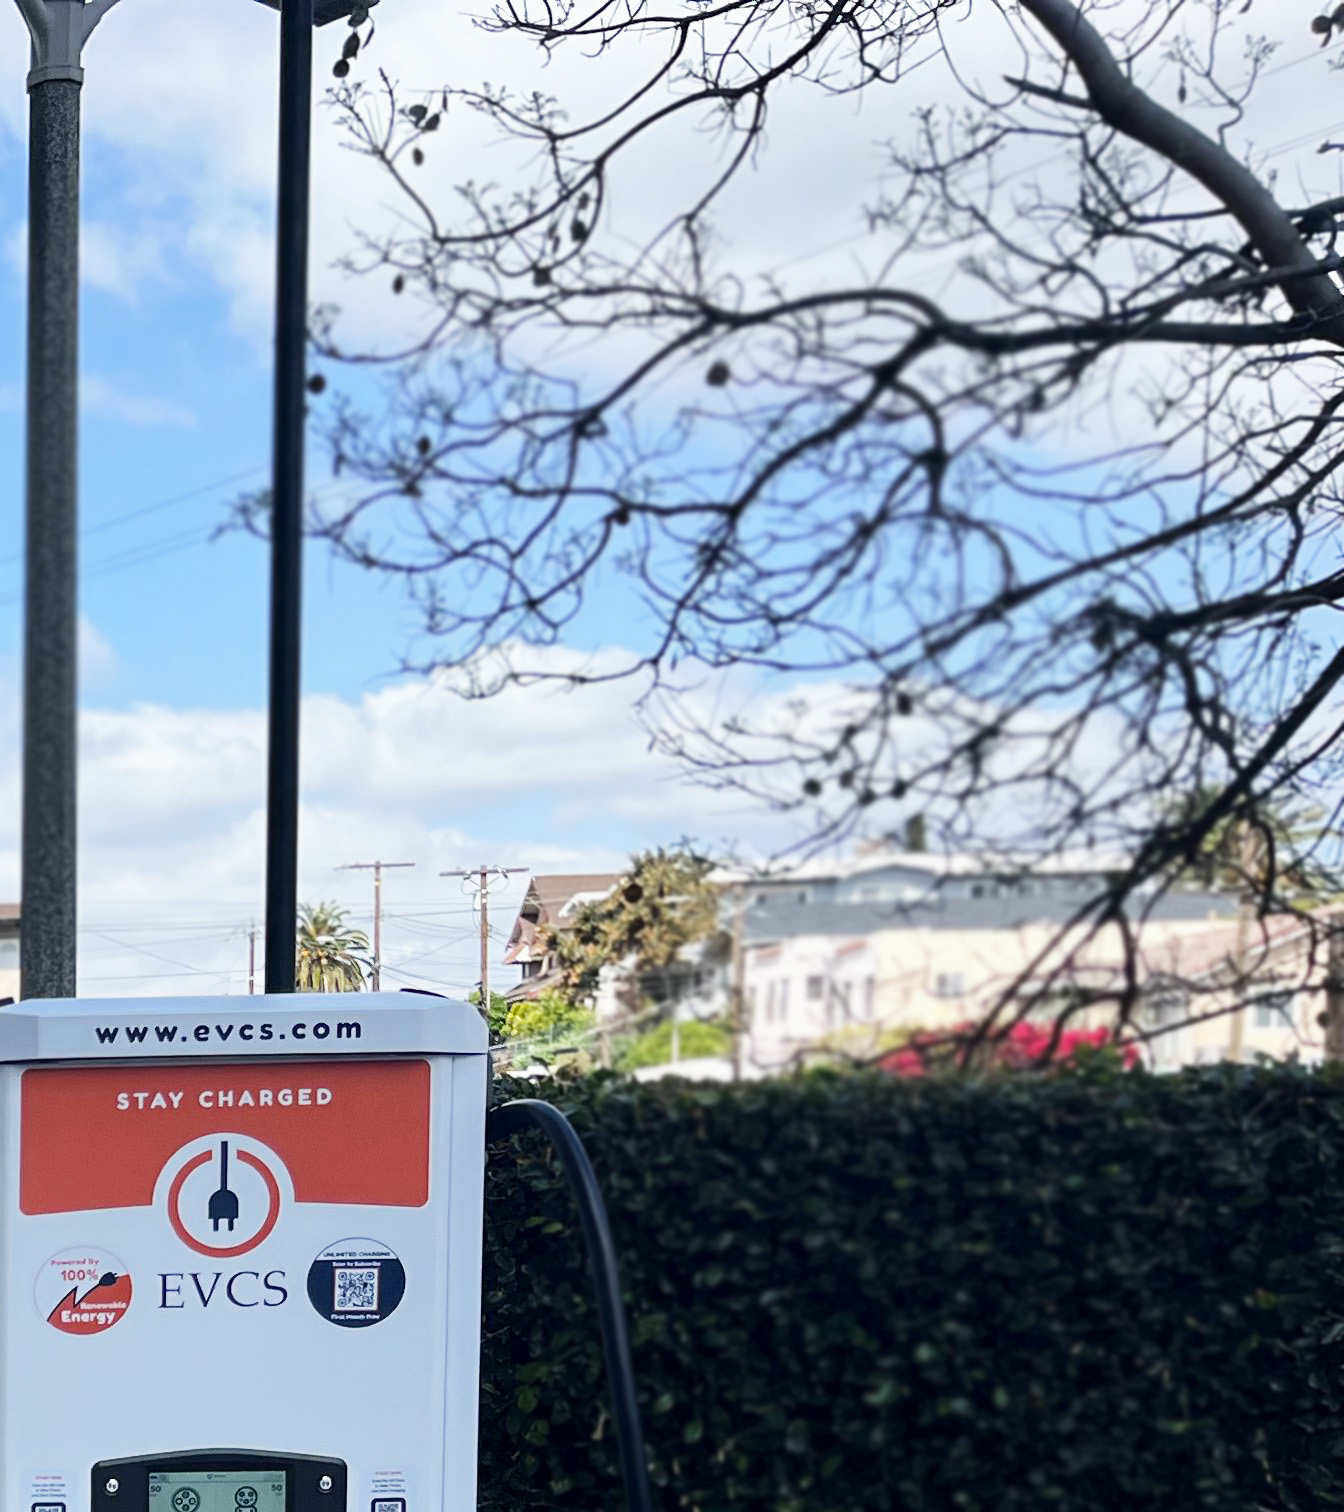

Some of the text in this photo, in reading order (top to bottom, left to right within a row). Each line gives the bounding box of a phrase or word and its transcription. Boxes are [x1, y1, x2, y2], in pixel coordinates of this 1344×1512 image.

[96, 1017, 362, 1043] www.evcs.com
[117, 1087, 333, 1111] STAY CHARGED
[61, 1268, 99, 1281] 100%
[157, 1269, 288, 1309] EVCS
[61, 1310, 116, 1325] Energy
[151, 1485, 161, 1493] 50
[272, 1484, 282, 1492] 50
